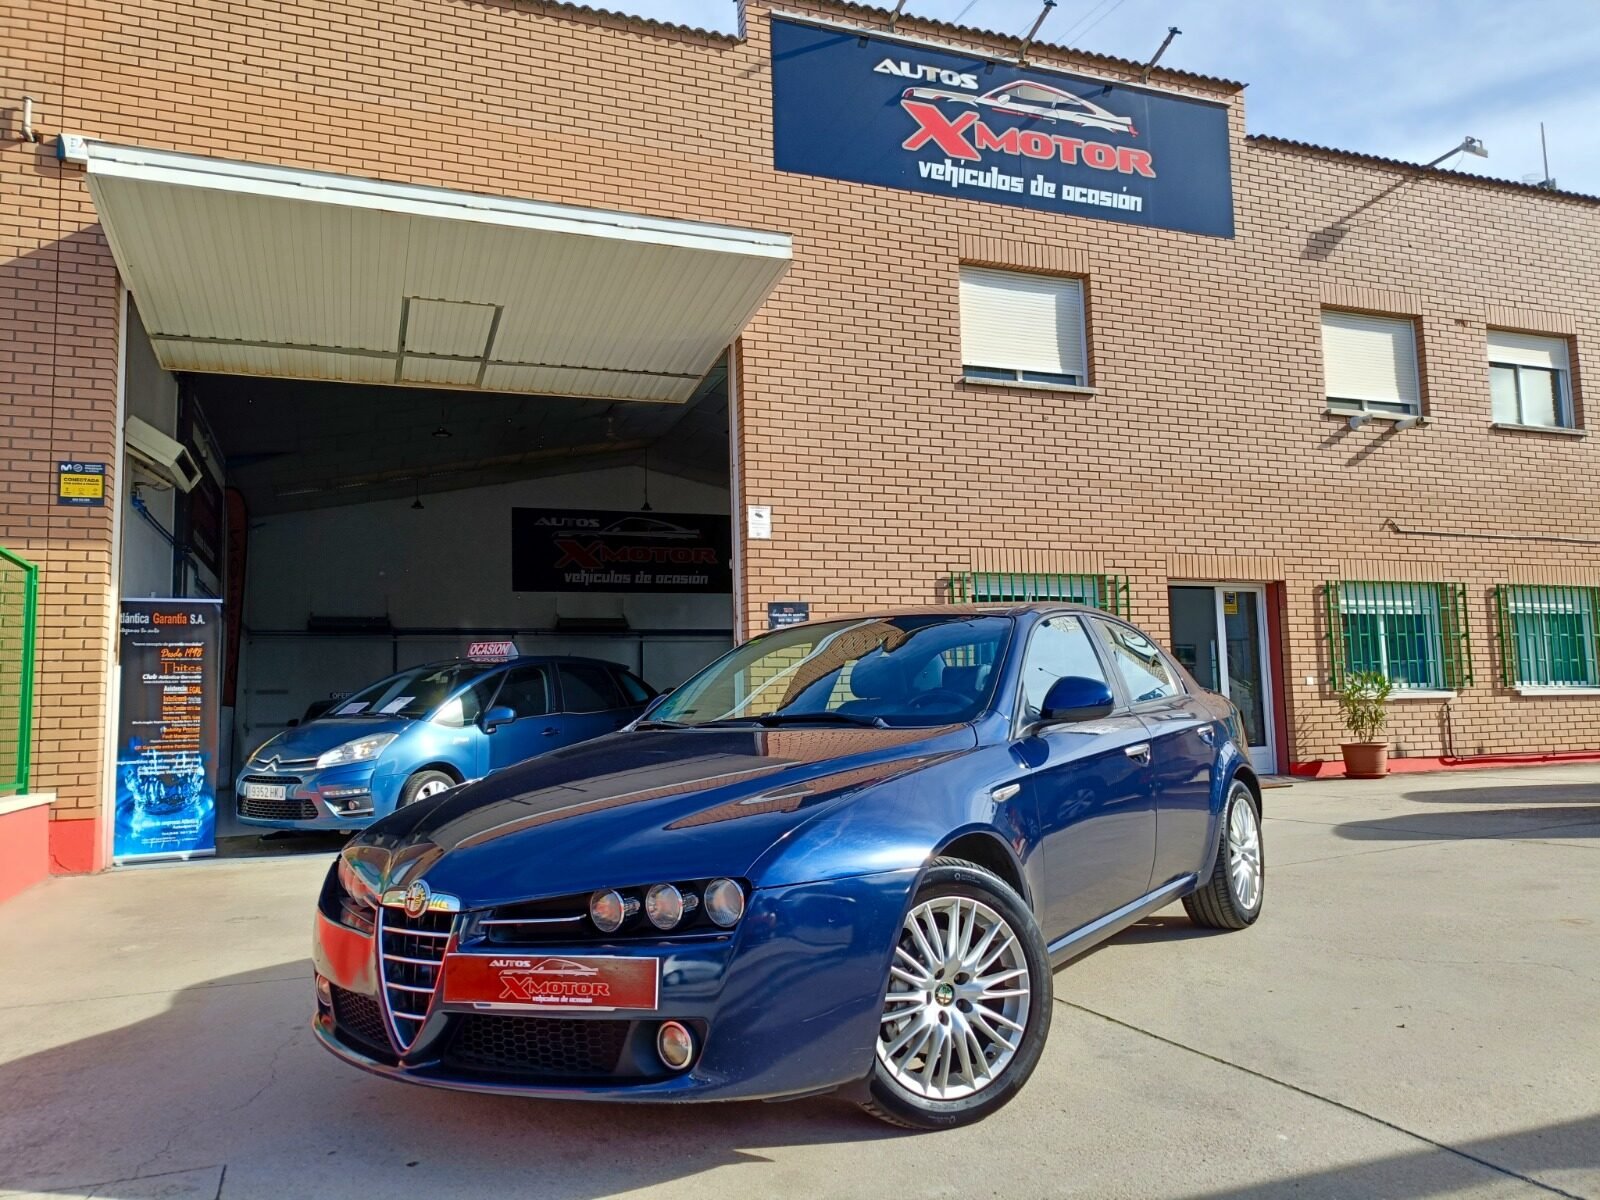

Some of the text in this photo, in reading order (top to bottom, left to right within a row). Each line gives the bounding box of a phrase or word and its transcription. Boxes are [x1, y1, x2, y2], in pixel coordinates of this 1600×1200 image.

[873, 58, 979, 90] AUTOS
[901, 99, 1156, 178] XMOTOR
[918, 159, 1143, 212] vehículos de ocasión
[533, 516, 600, 528] AUTOS
[553, 538, 718, 569] XMOTOR
[634, 571, 651, 584] de
[120, 612, 206, 625] tlántica Garantía S.A.
[489, 959, 531, 967] AUTOS
[499, 976, 610, 1000] XMOTOR
